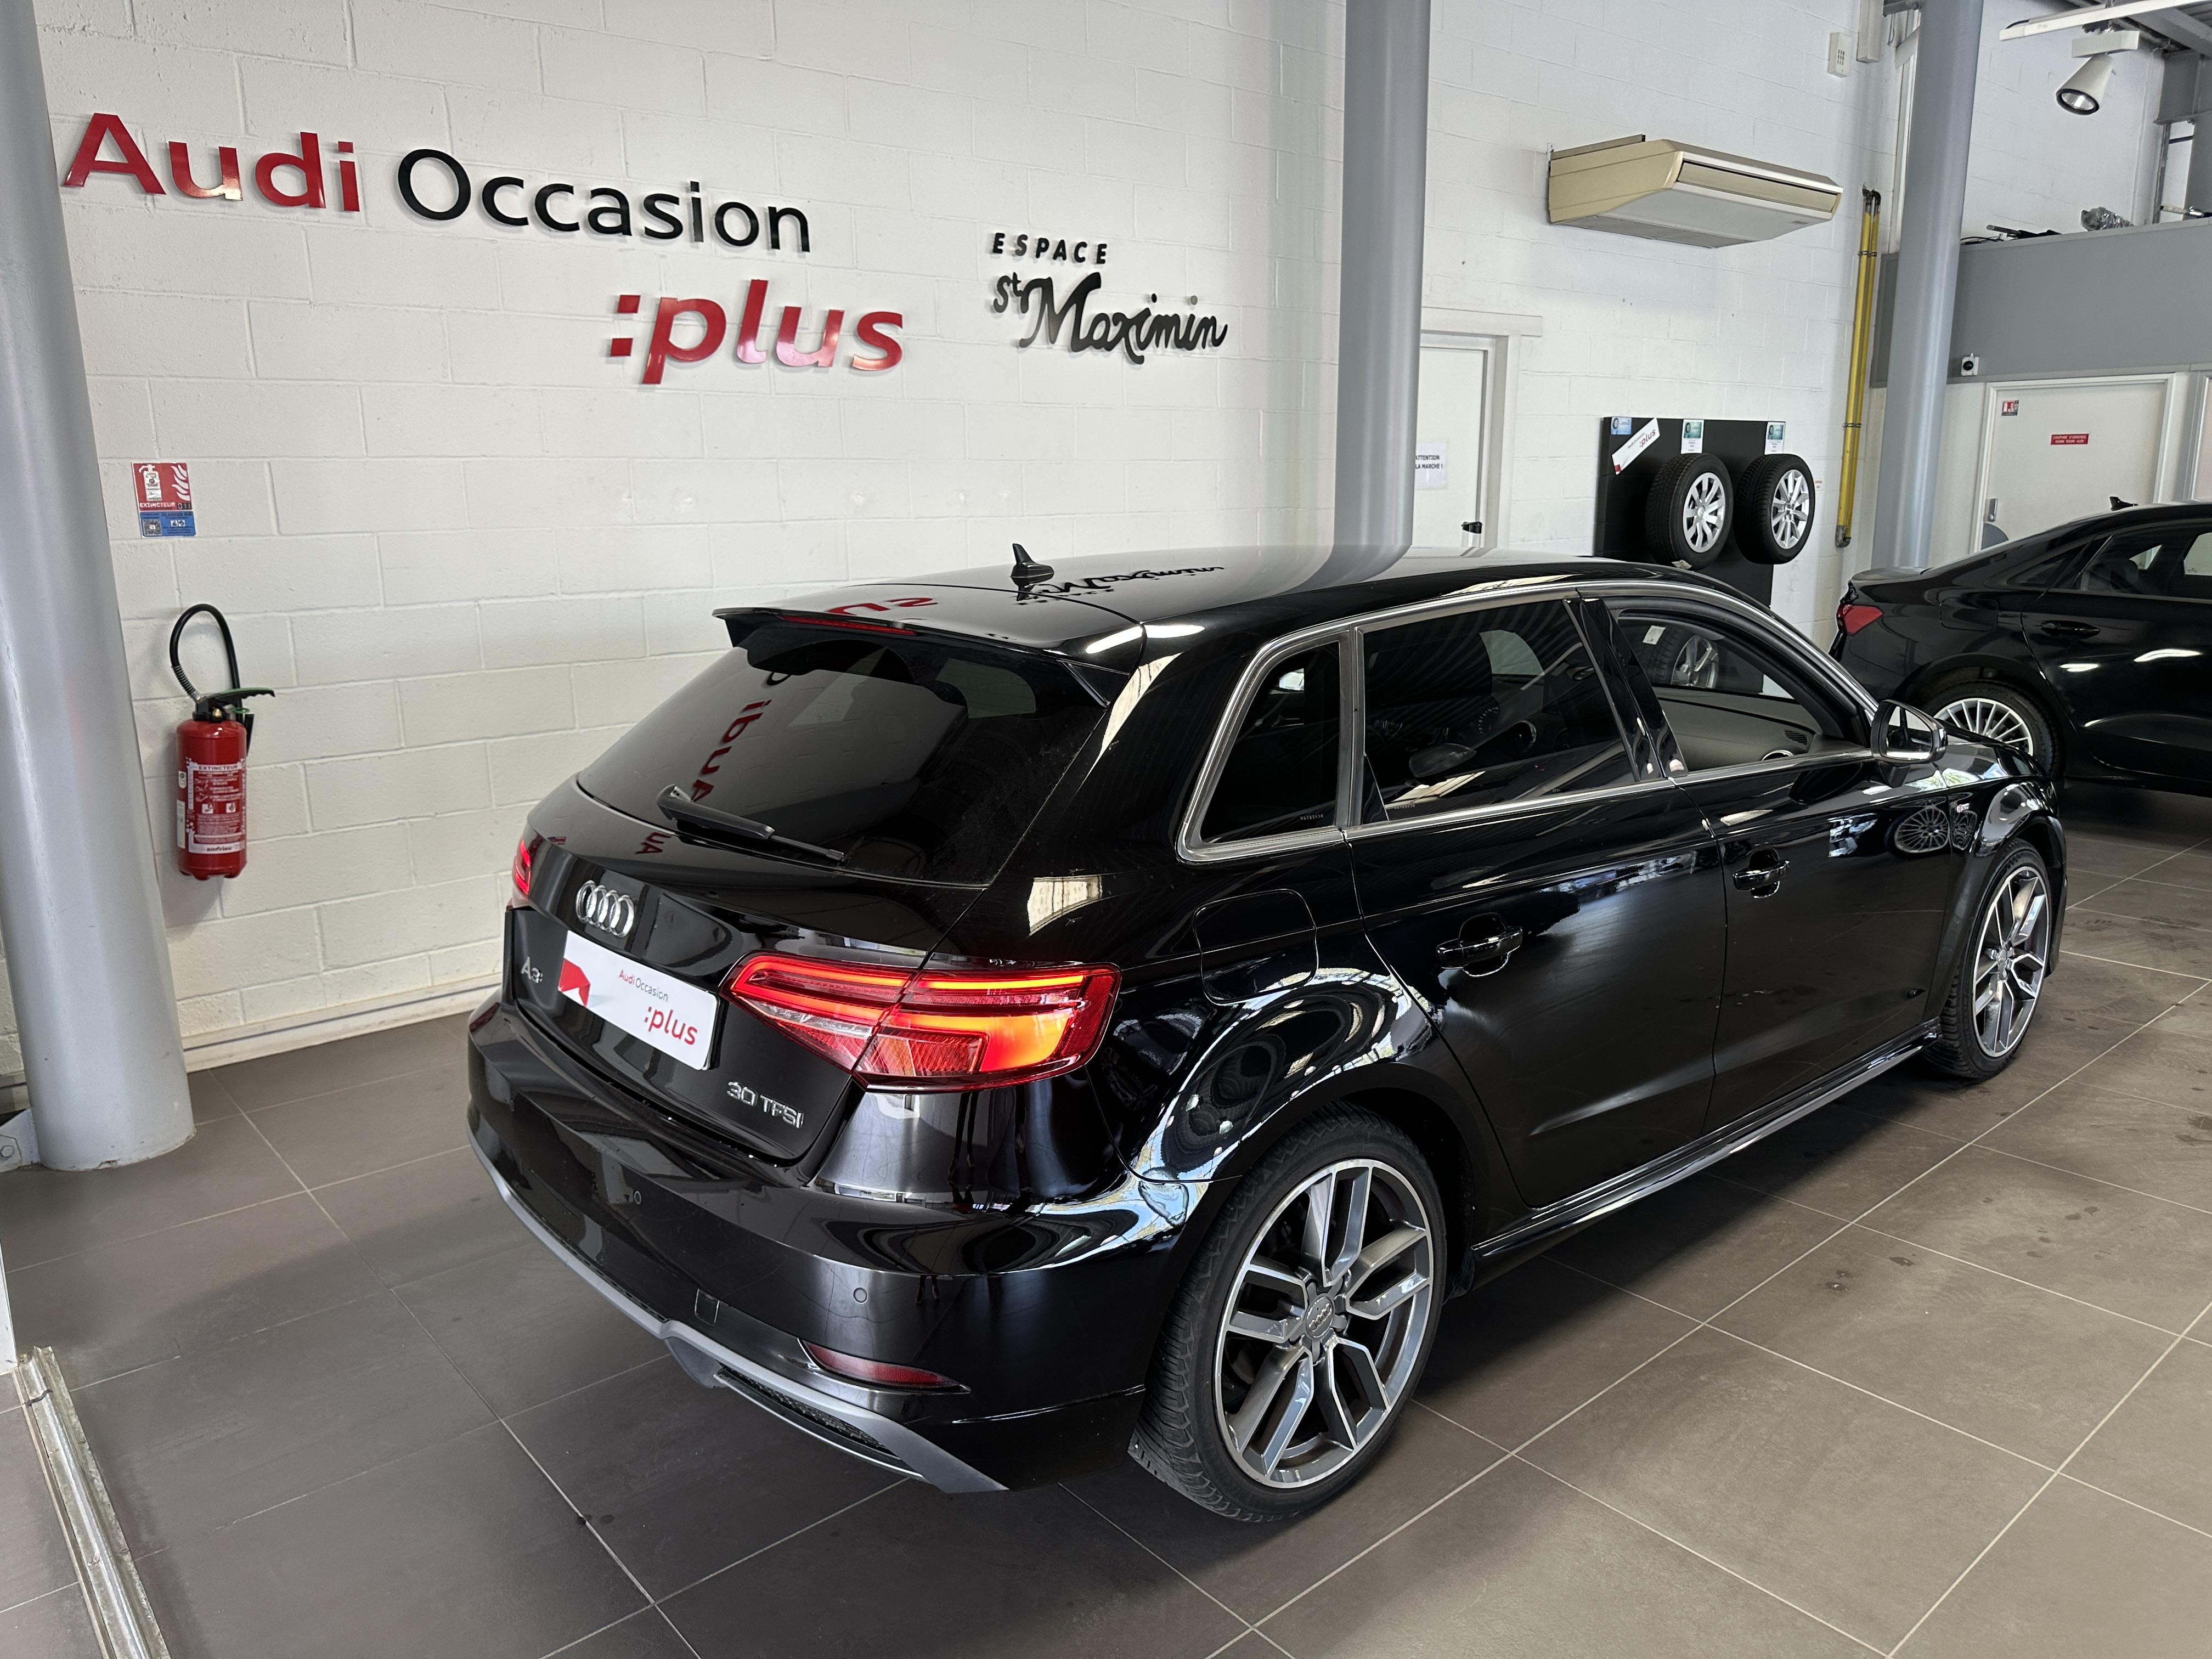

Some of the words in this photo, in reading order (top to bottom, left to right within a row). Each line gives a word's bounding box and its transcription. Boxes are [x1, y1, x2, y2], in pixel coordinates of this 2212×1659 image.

[63, 112, 360, 212] Audi
[397, 148, 811, 253] Occasion
[992, 233, 1108, 264] ESPACE
[610, 279, 904, 385] :plus
[1019, 272, 1228, 365] Maximin
[521, 956, 543, 984] A3
[619, 969, 635, 985] Audi
[635, 978, 669, 1002] Occasion
[644, 1006, 698, 1046] :plus
[727, 1081, 755, 1107] 30
[760, 1094, 804, 1128] TFSI
